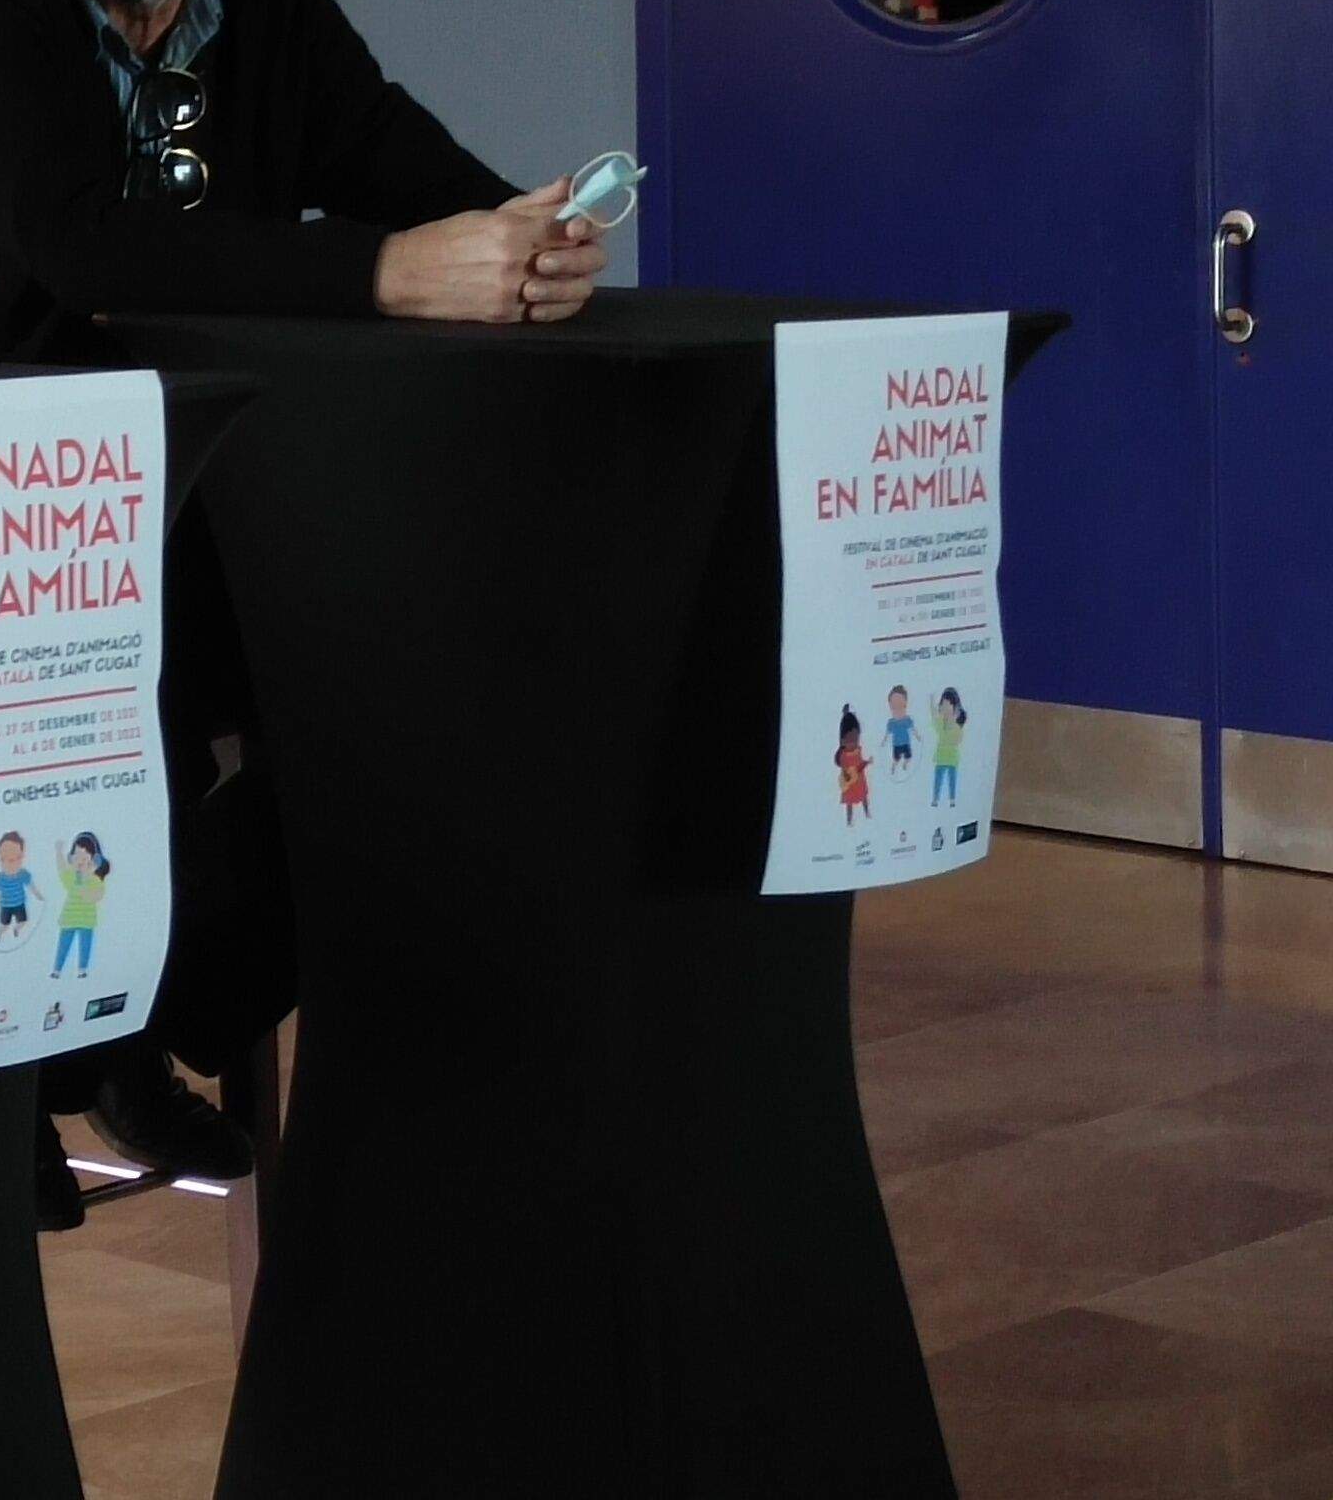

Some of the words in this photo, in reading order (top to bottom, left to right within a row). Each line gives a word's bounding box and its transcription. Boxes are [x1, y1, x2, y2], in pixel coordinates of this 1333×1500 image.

[887, 364, 989, 411] NADAL
[871, 414, 987, 464] ANIMAT
[817, 476, 858, 521] EN
[873, 456, 987, 515] FAMÍLIA
[10, 644, 61, 665] CINEMA
[38, 666, 55, 682] DE
[58, 658, 92, 679] SANT
[95, 653, 142, 673] CUGAT
[38, 710, 97, 732] DESEMBRE
[59, 732, 96, 750] GENER
[2, 781, 61, 805] CINEMES
[64, 775, 98, 796] SANT
[101, 768, 147, 790] CUGAT
